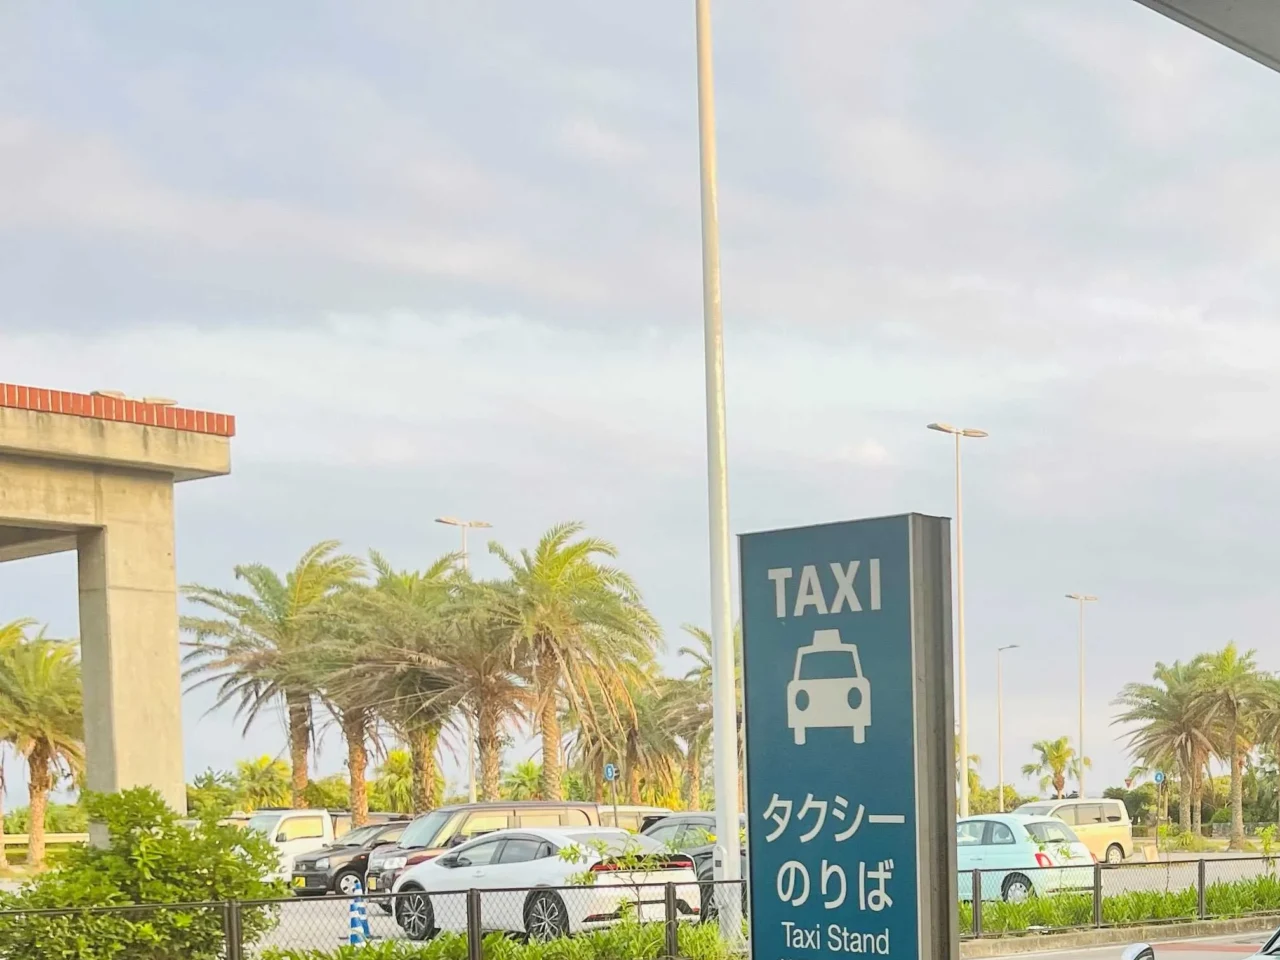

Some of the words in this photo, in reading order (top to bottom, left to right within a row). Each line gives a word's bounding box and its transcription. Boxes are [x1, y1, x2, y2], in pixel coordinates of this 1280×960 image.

[767, 558, 882, 618] TAXI
[762, 793, 906, 843] タクシー
[776, 858, 895, 912] のりば
[781, 921, 821, 950] Taxi
[827, 924, 890, 955] Stand
